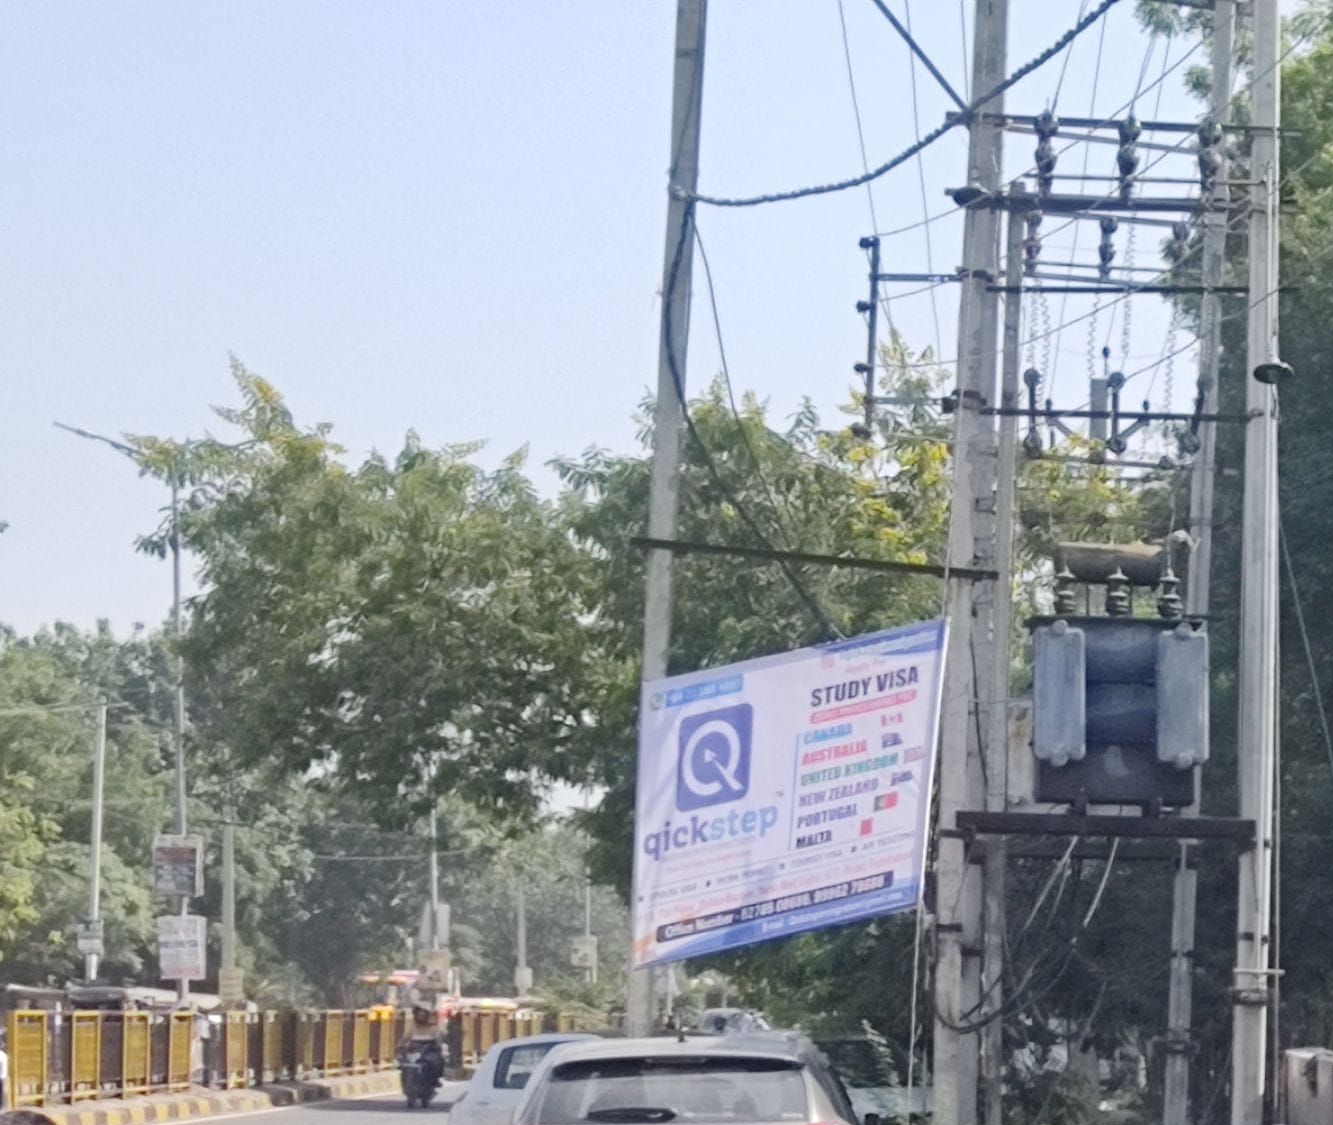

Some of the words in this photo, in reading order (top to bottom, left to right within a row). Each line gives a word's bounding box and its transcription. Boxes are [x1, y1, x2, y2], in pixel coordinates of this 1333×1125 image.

[811, 677, 872, 707] STUDY
[876, 666, 919, 692] VISA
[802, 739, 868, 765] AUSTRALIA
[800, 766, 842, 787] UNITED
[799, 788, 826, 807] NEW
[797, 803, 857, 829] PORTUGAL
[643, 805, 779, 861] qickstep
